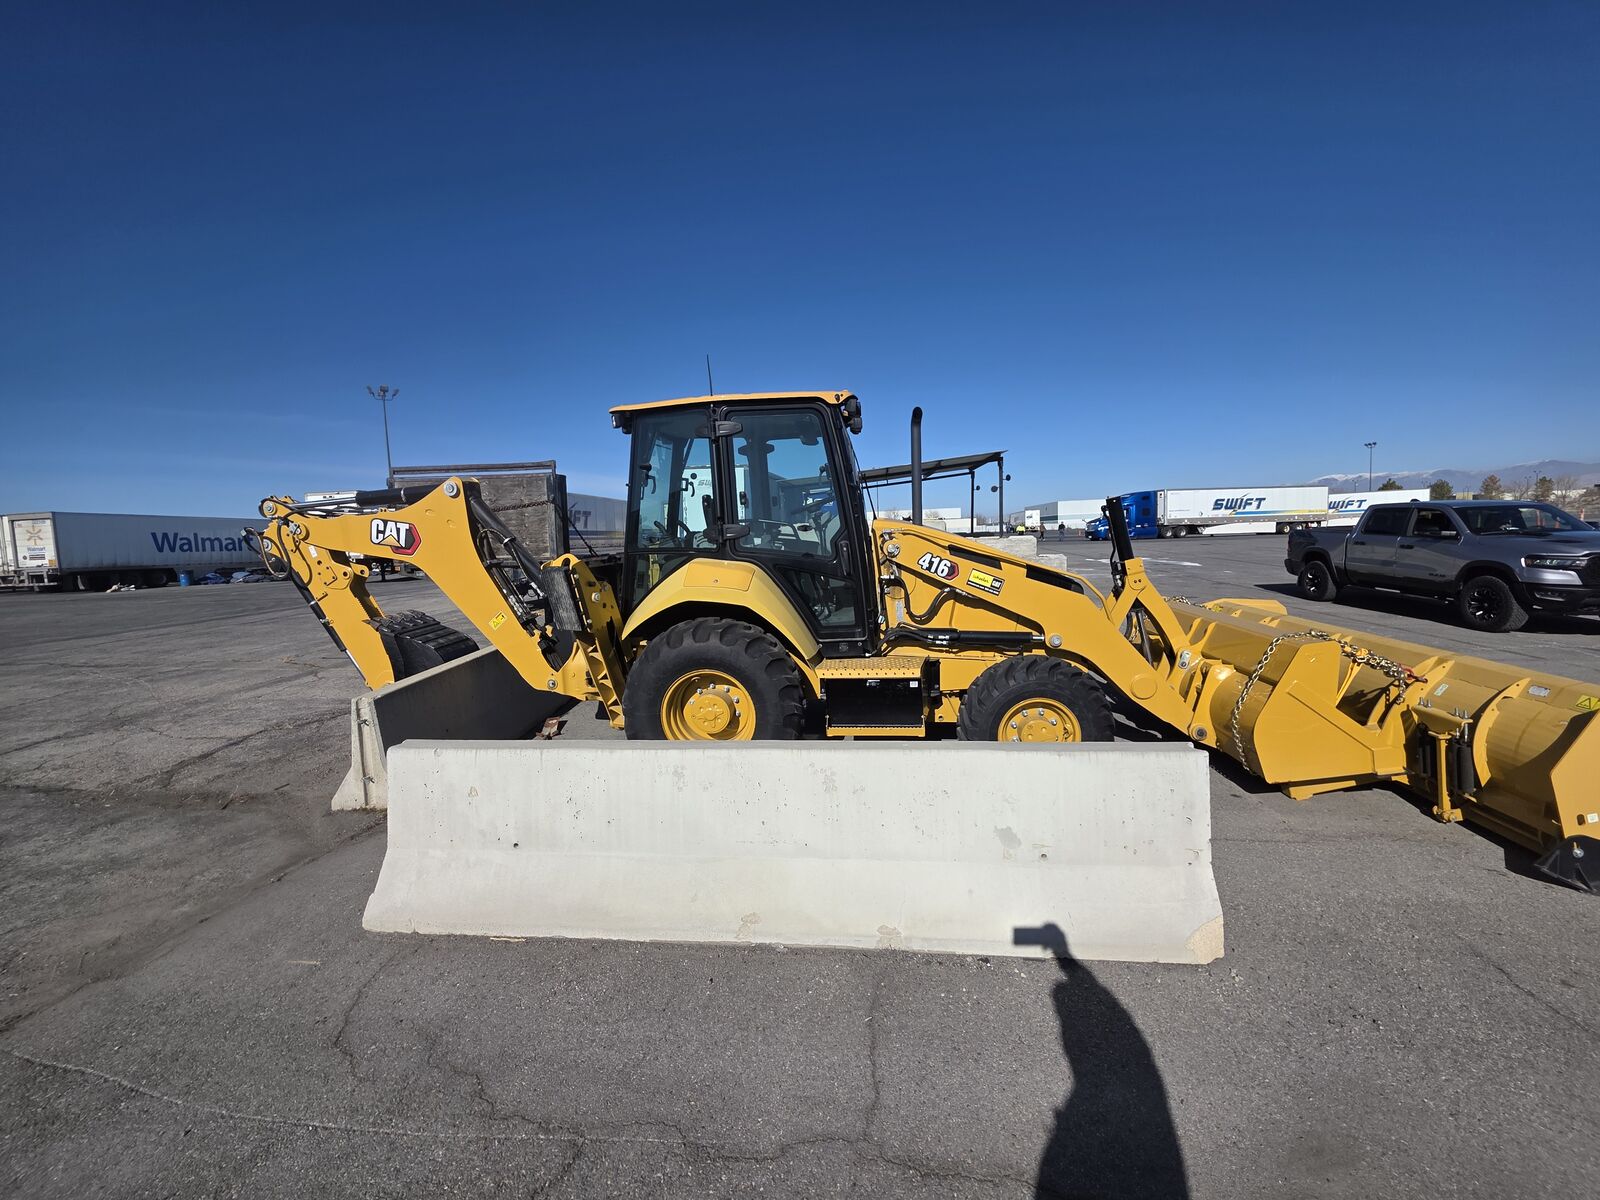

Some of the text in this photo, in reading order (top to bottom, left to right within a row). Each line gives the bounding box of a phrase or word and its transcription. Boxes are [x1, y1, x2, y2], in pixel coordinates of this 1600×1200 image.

[1212, 496, 1266, 511] SWIFT
[1328, 499, 1367, 509] WIFT
[371, 518, 410, 548] CAT
[917, 552, 952, 578] 416
